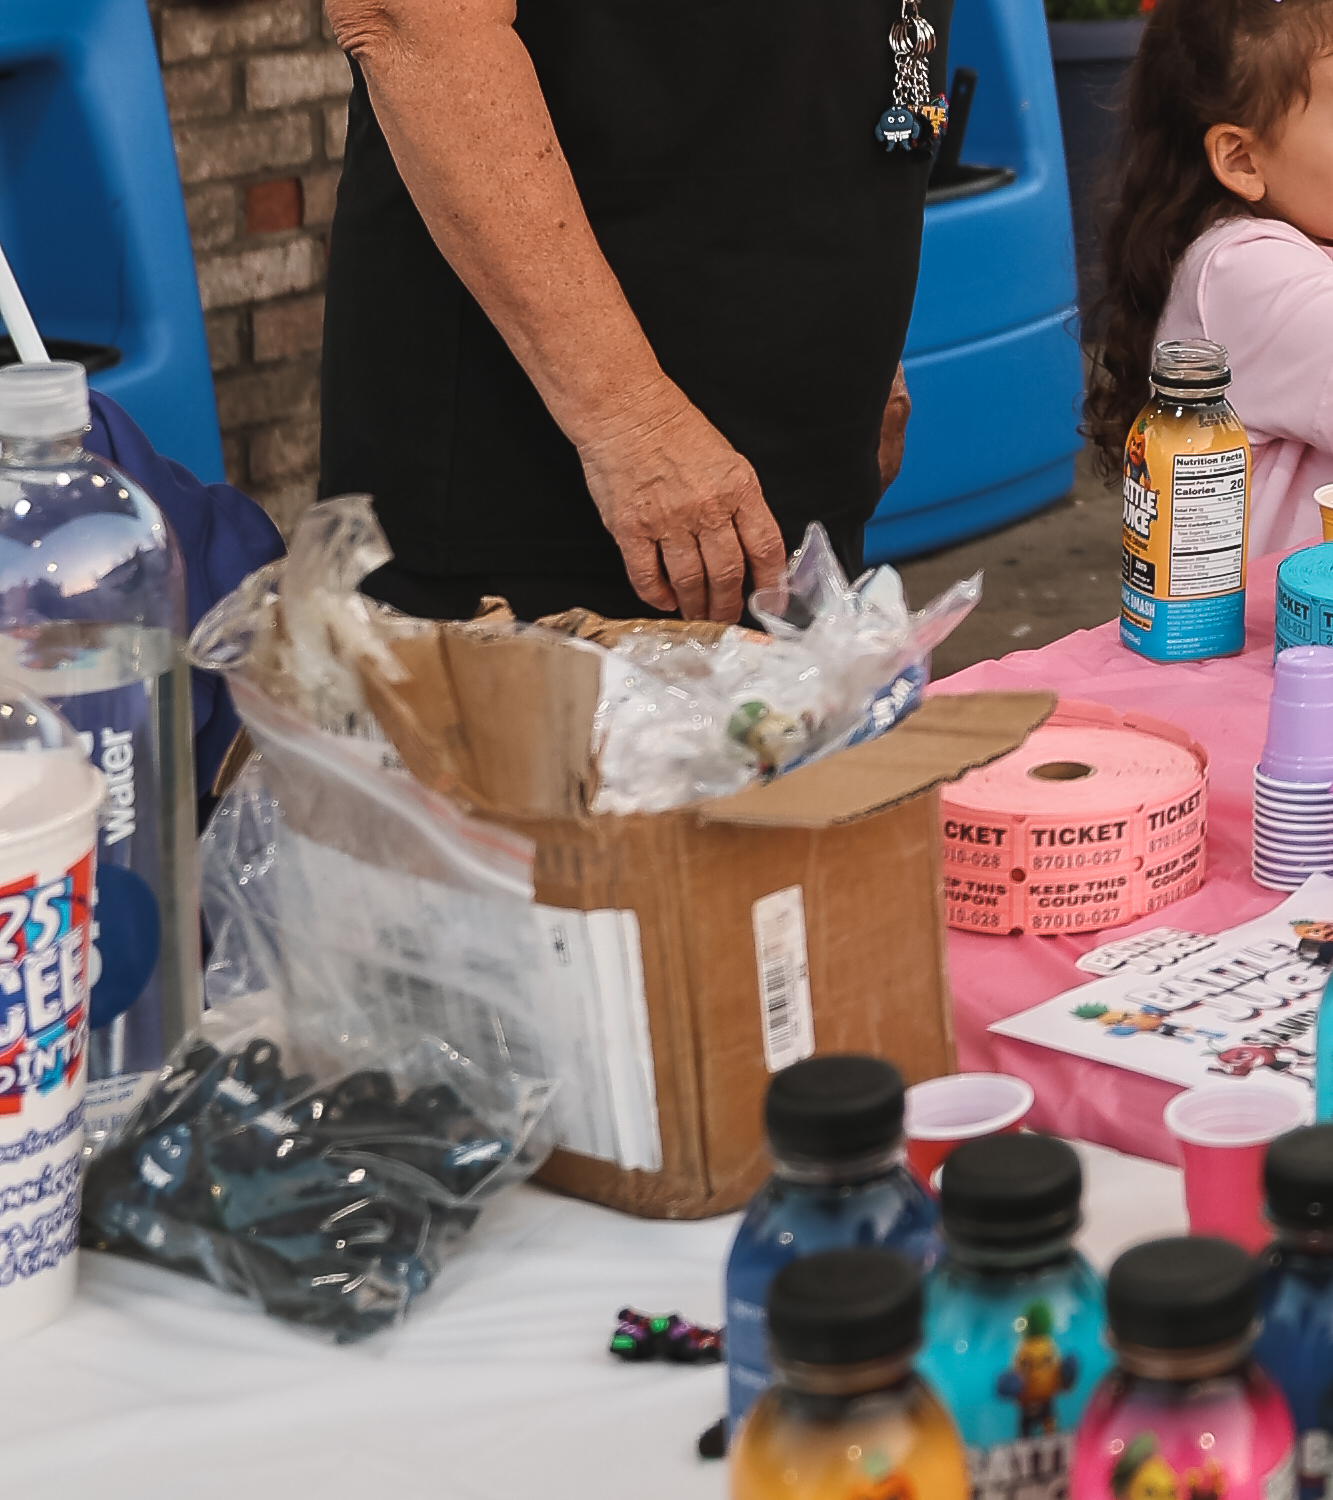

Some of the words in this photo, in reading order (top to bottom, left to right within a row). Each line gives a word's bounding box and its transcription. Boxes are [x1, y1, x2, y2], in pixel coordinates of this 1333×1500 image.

[1176, 457, 1218, 466] Nutrition
[1221, 452, 1242, 463] Facts
[1123, 476, 1157, 516] ATTLE
[1175, 487, 1216, 496] Calories
[1230, 478, 1244, 491] 20
[104, 727, 136, 846] Water
[1148, 790, 1201, 831] TICKET
[944, 820, 1006, 847] CKET
[1031, 820, 1128, 847] TICKET
[1033, 849, 1122, 871] 87010-027
[1146, 856, 1179, 880] KEEP
[1030, 884, 1080, 896] KEEP
[1084, 875, 1127, 890] THIS
[1151, 860, 1197, 890] COUPON
[945, 890, 998, 907] UPON
[966, 881, 1006, 895] THIS
[1037, 889, 1119, 908] COUPON
[1032, 907, 1121, 929] 87010-027
[0, 922, 87, 1040] CEE
[1127, 938, 1300, 1012] BATTLE
